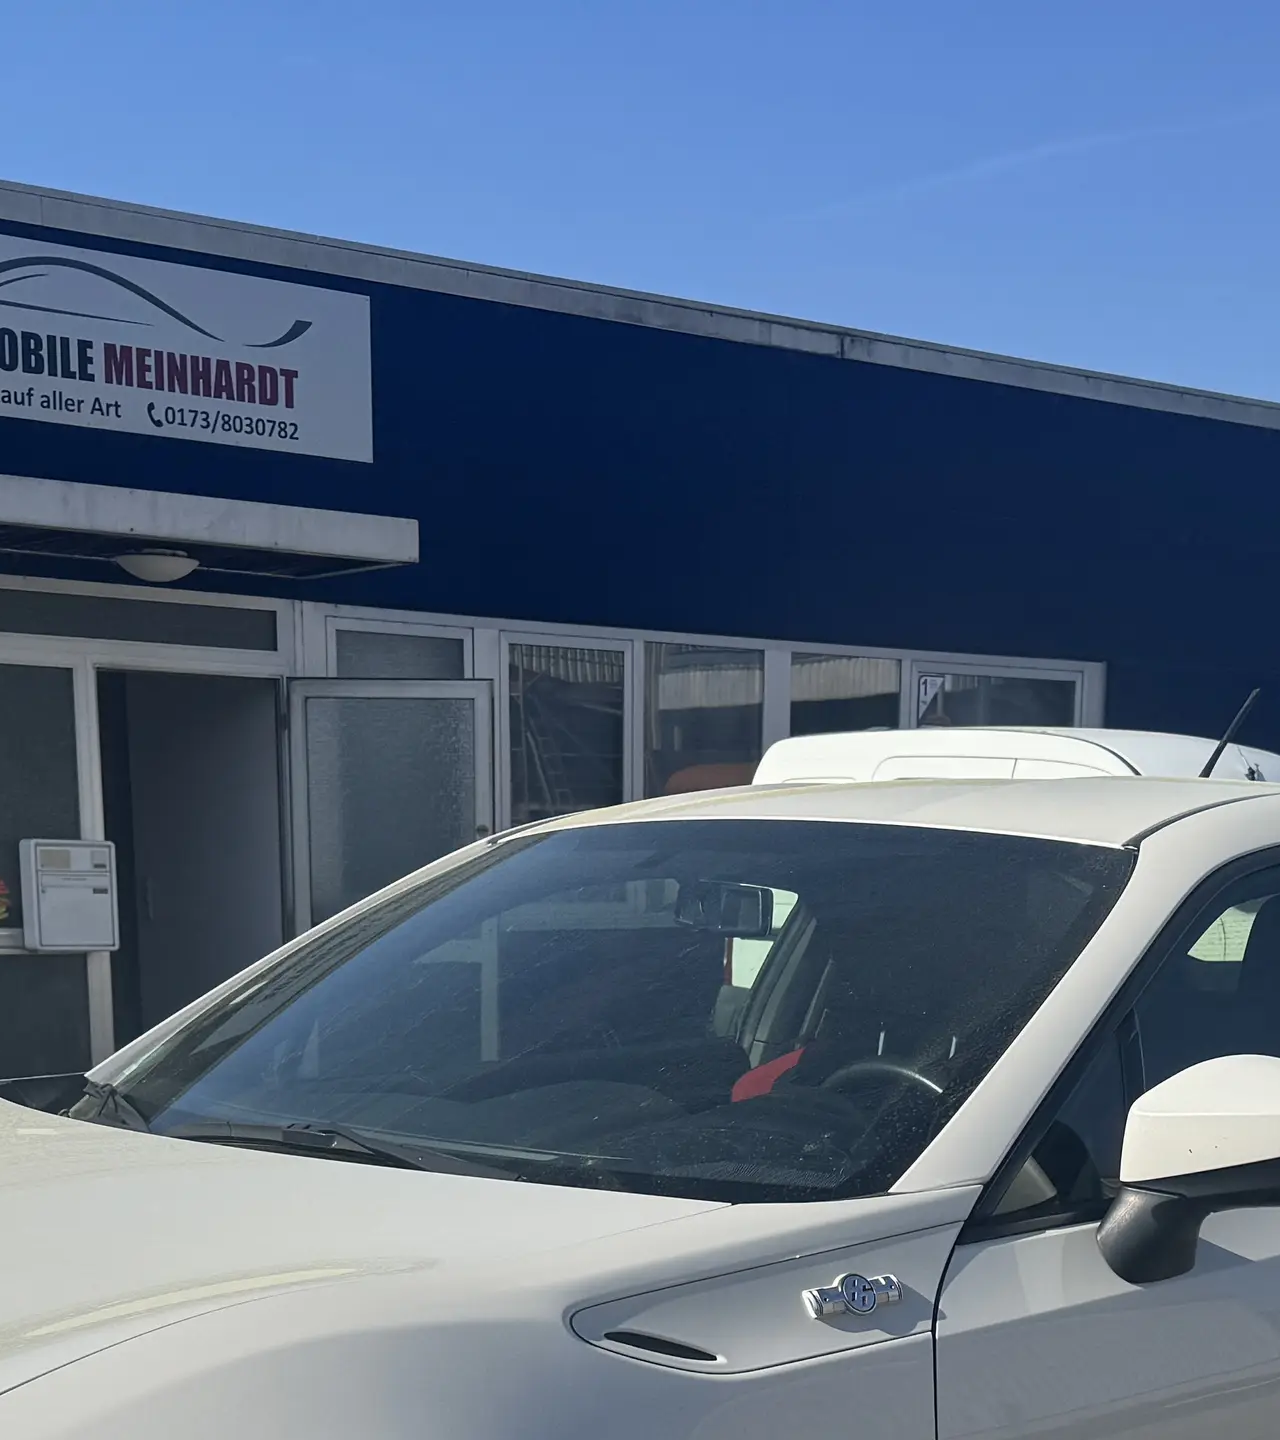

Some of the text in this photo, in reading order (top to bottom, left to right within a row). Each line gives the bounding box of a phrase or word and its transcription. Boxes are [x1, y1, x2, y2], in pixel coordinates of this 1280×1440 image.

[103, 342, 299, 409] MEINHARDT
[40, 390, 85, 414] aller
[90, 397, 122, 419] Art
[164, 406, 300, 441] 0173/8030782
